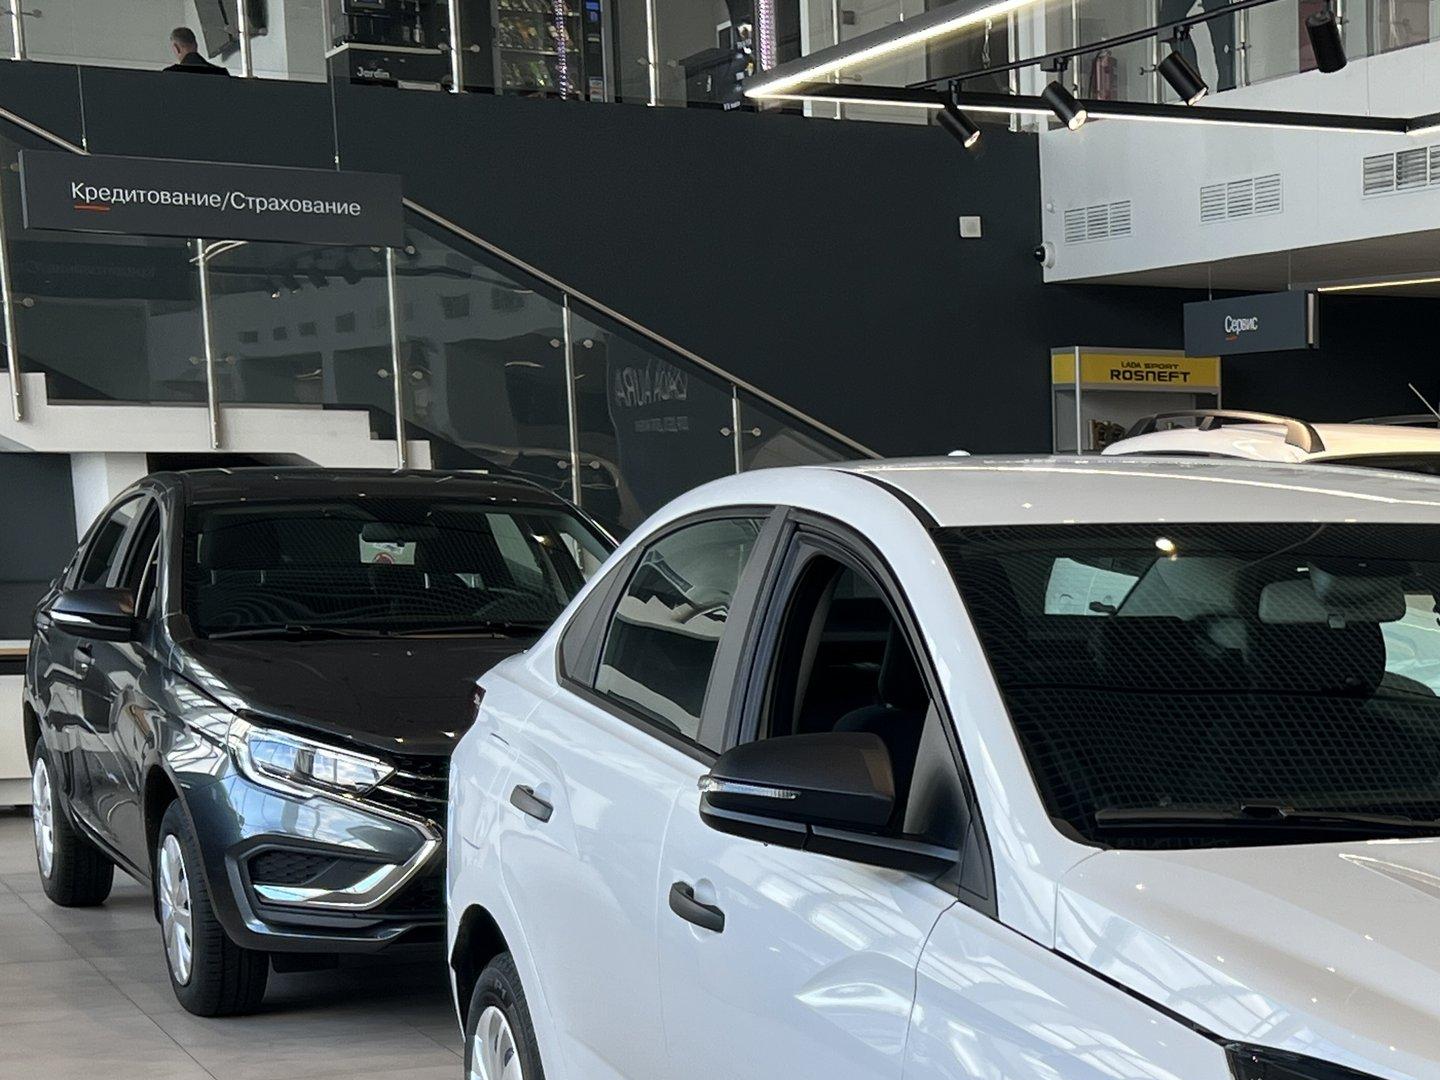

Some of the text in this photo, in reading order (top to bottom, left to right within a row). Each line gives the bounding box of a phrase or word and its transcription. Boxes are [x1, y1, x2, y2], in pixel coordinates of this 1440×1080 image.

[71, 182, 361, 216] Кредитование/Страхование
[1224, 315, 1259, 335] Сервис
[1120, 361, 1179, 370] LADA SPORT
[1110, 369, 1191, 383] ROSNEFT
